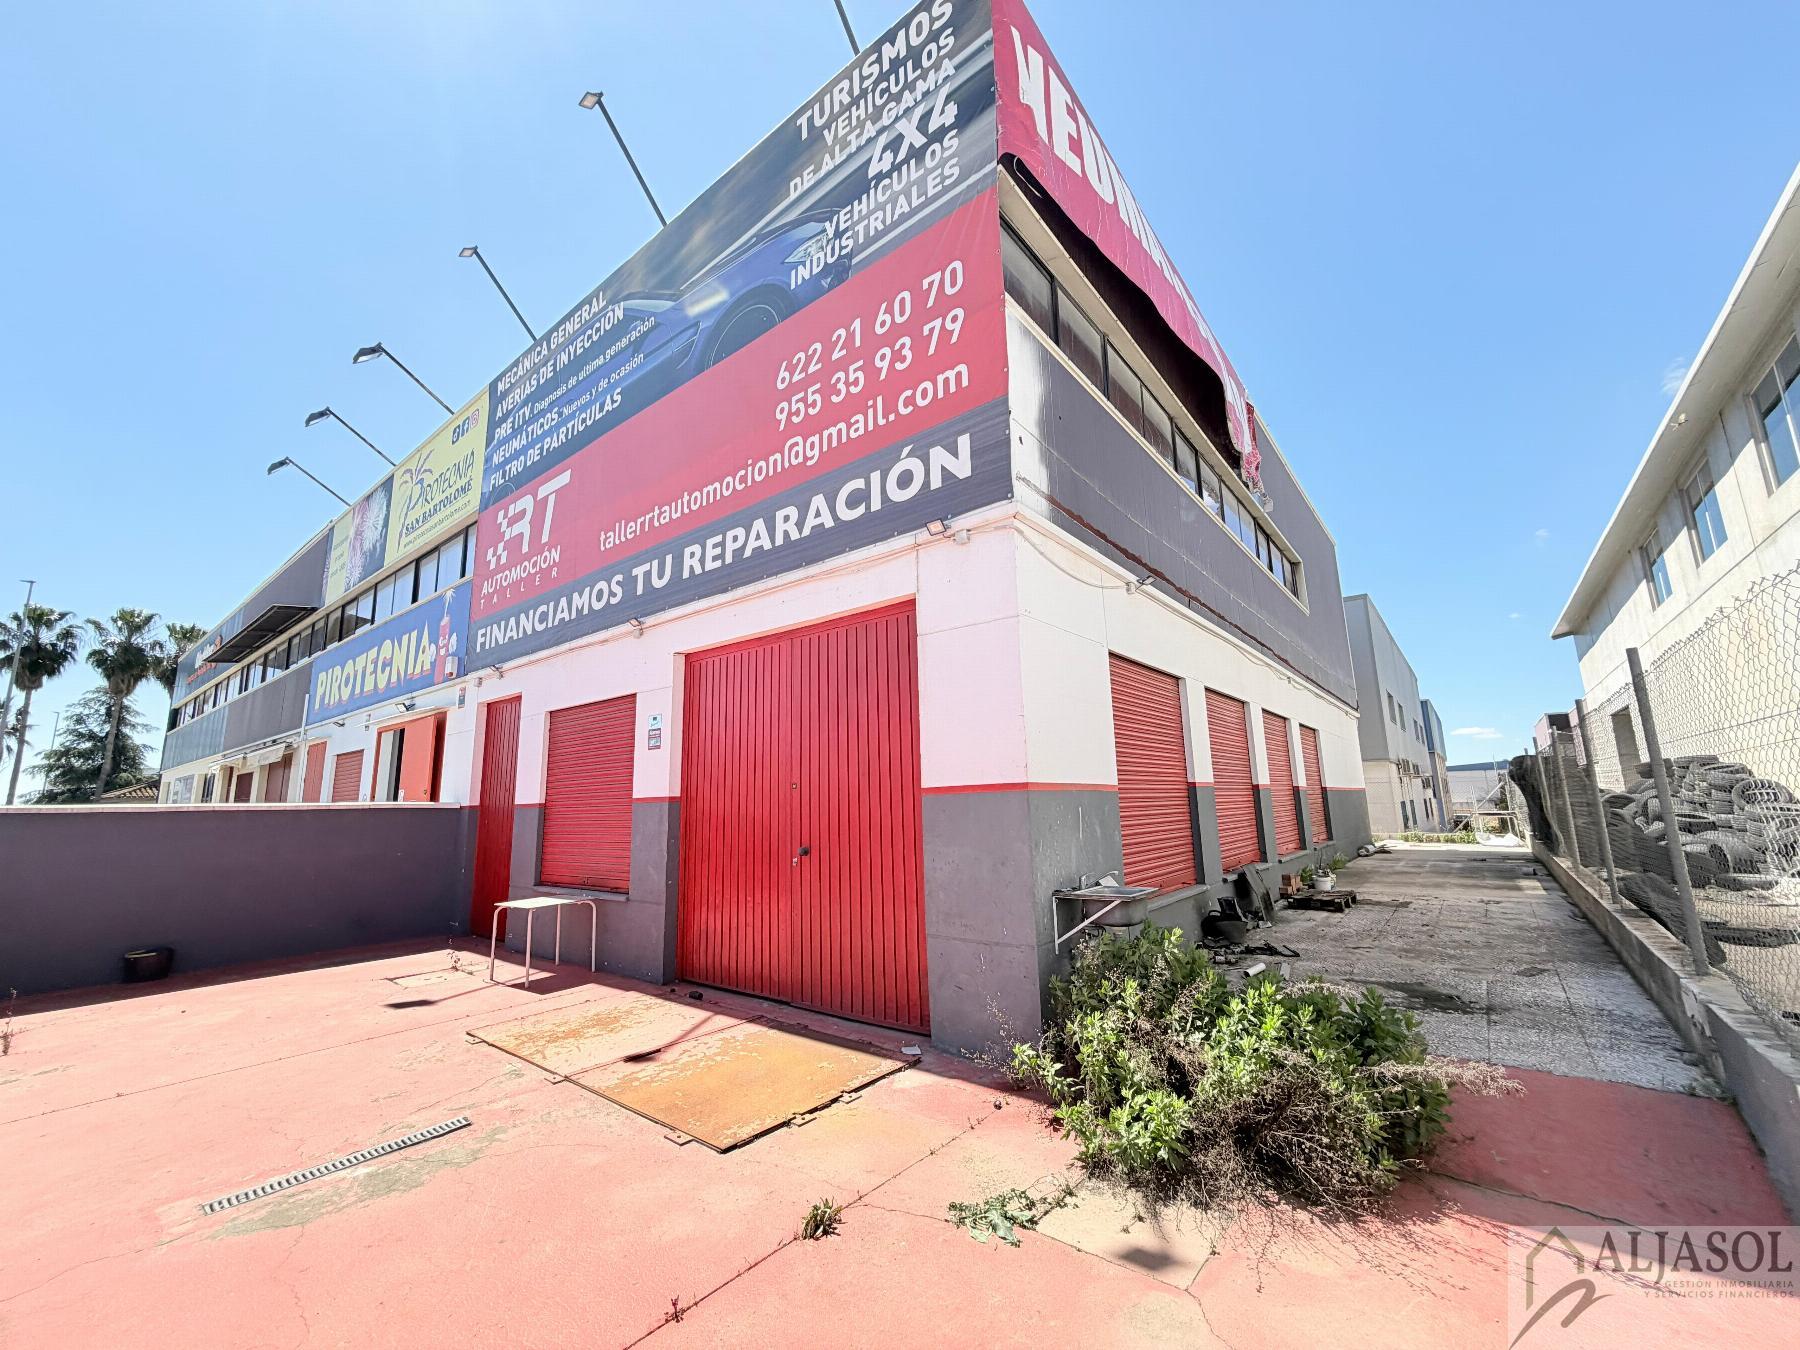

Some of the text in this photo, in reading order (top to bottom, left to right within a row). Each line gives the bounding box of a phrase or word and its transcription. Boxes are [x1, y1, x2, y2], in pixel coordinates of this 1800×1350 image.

[789, 58, 955, 198] DE ALTA GAMA
[797, 0, 953, 141] TURISMOS
[823, 27, 955, 146] VEHÍCULOS
[824, 129, 959, 238] VEHÍCULOS
[868, 84, 958, 179] 4X4
[791, 157, 960, 290] INDUSTRIALES
[494, 418, 513, 444] PRE
[534, 384, 567, 414] Diagnosis
[568, 374, 578, 388] de
[605, 316, 655, 362] generación
[496, 302, 624, 421] AVERIAS DE INYECCIÓN
[497, 291, 607, 397] MECÁNICA GENERAL
[562, 392, 591, 417] Nuevos
[591, 386, 598, 401] y
[598, 378, 609, 392] de
[610, 352, 645, 383] ocasión
[775, 308, 965, 431] 955 35 93 79
[776, 260, 964, 390] 622 21 60 70
[408, 447, 475, 512] PIROTECNIA
[489, 387, 622, 491] FILTRO DE PARTÍCULAS
[600, 363, 969, 553] tallerrtautomocion@gmail.com
[404, 477, 473, 536] SAN BARTOLOMÉ
[476, 433, 972, 652] FINANCIAMOS TU REPARACIÓN
[481, 544, 561, 597] AUTOMOCIÓN
[315, 619, 431, 711] PIROTECNIA
